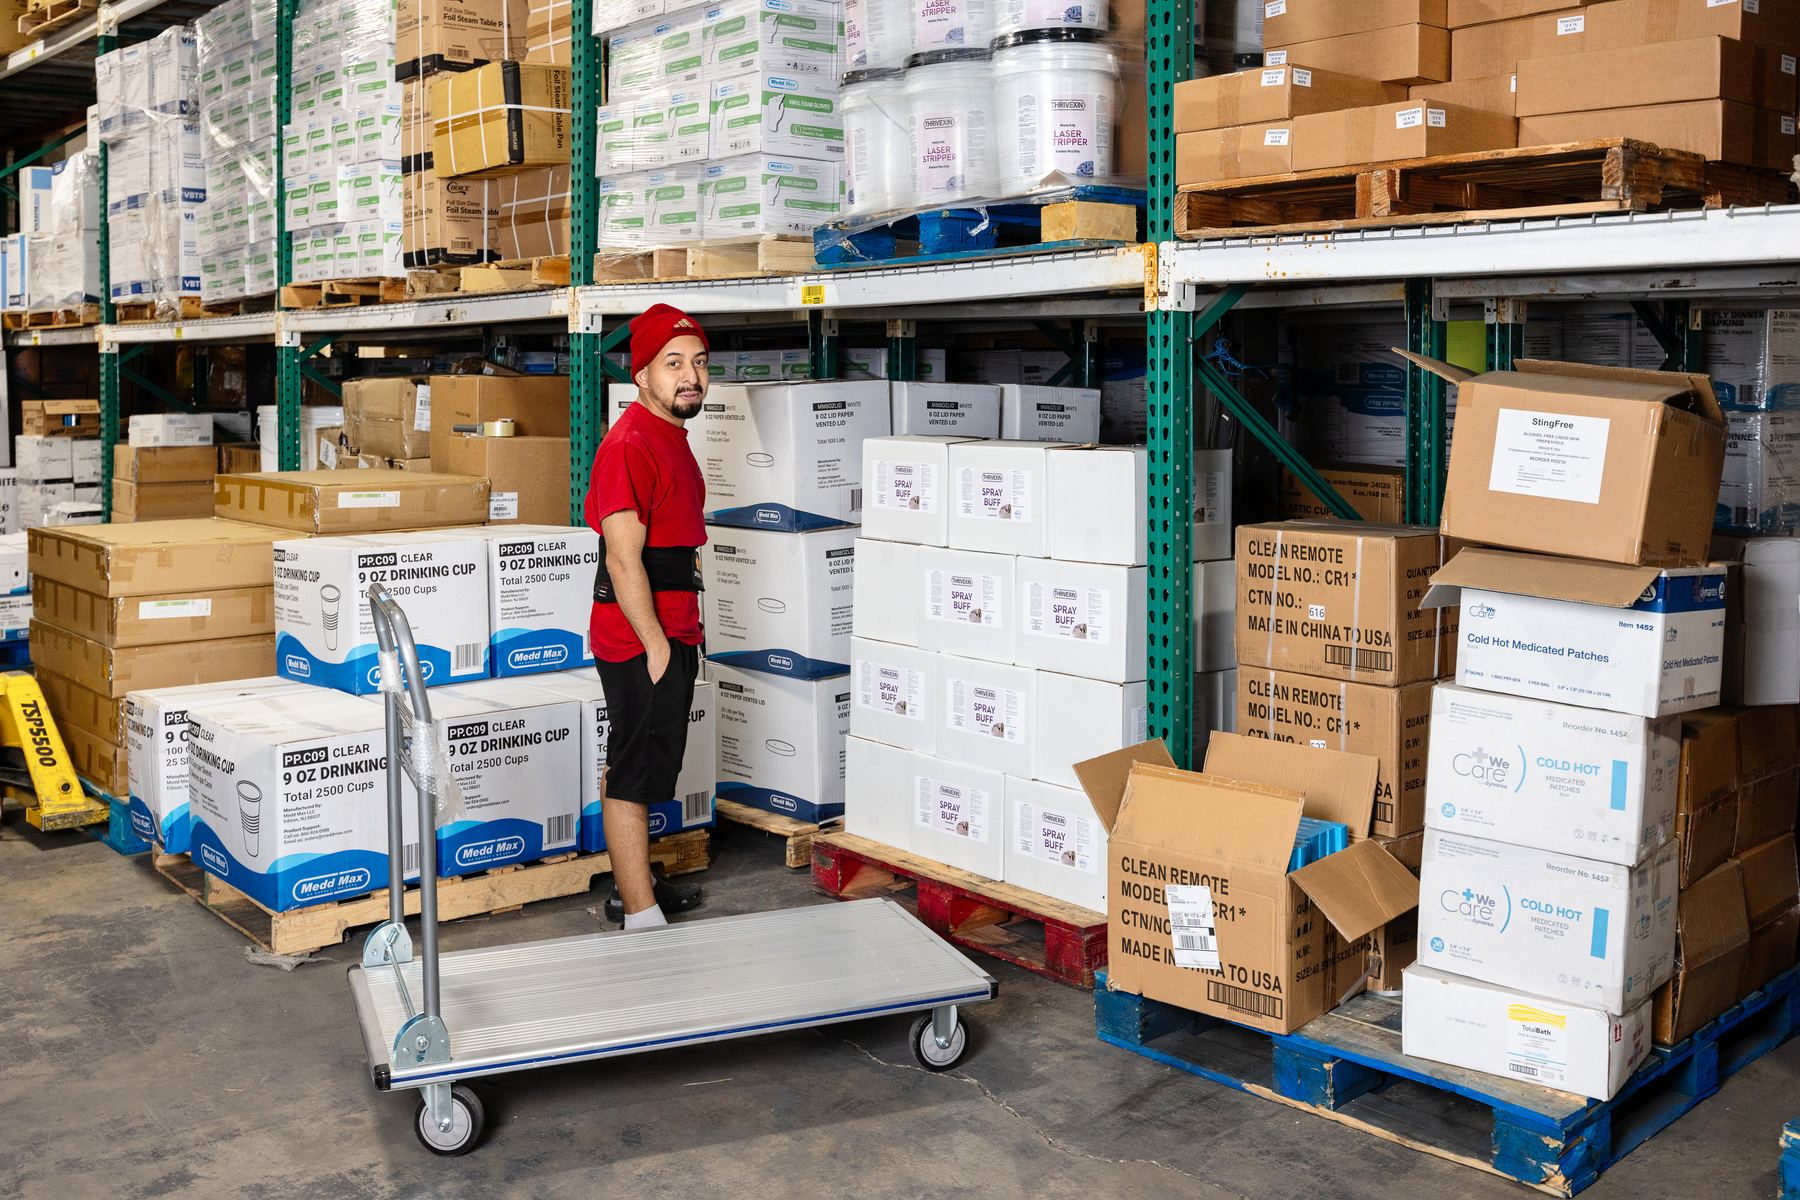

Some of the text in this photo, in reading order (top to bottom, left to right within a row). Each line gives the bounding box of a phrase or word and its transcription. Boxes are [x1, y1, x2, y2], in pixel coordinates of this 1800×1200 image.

[922, 6, 957, 18] STRIPPER
[457, 16, 479, 24] Steam
[801, 100, 814, 108] EXAM
[814, 102, 831, 110] GLOVES
[1051, 100, 1084, 108] THRIVEXIN
[925, 119, 953, 128] THRIVEXIN
[1054, 130, 1082, 138] LASER
[926, 146, 951, 154] LASER
[922, 154, 956, 162] STRIPPER
[446, 206, 482, 215] Foil Steam
[1532, 418, 1574, 430] StingFree
[894, 480, 913, 488] SPRAY
[896, 489, 911, 498] BUFF
[982, 488, 1003, 497] SPRAY
[983, 498, 1001, 506] BUFF
[500, 542, 566, 556] PP.C09 CLEAR
[1248, 540, 1344, 564] CLEAN REMOTE
[359, 552, 433, 567] PP.C09 CLEAR
[500, 554, 581, 572] 9 OZ DRINKING
[308, 571, 320, 582] CUP
[358, 564, 476, 584] 9 OZ DRINKING CUP
[829, 568, 850, 576] VENTED
[1248, 563, 1291, 582] MODEL
[500, 572, 570, 586] Total 2500 Cups
[414, 584, 438, 596] Cups
[951, 590, 973, 601] SPRAY
[953, 600, 972, 610] BUFF
[1052, 604, 1078, 615] SPRAY
[1486, 606, 1496, 614] We
[1308, 607, 1325, 618] 616
[1468, 604, 1495, 620] Care
[1054, 615, 1075, 625] BUFF
[1618, 620, 1654, 632] Item 1452
[1248, 616, 1392, 648] MADE IN CHINA TO USA
[1467, 633, 1610, 663] Cold Hot Medicated Patches
[514, 649, 563, 662] Medd Max
[1664, 660, 1672, 670] Cold
[1682, 656, 1703, 668] Medicated
[1703, 655, 1719, 664] Patches
[879, 682, 898, 692] SPRAY
[1248, 680, 1289, 701] CLEAN
[880, 692, 897, 702] BUFF
[974, 702, 996, 714] SPRAY
[975, 712, 994, 724] BUFF
[20, 700, 57, 768] TSP5500
[449, 720, 526, 738] PP.C09 CLEAR
[596, 725, 604, 738] 9
[1562, 722, 1629, 738] Reorder No. 1452
[165, 732, 174, 744] 9
[449, 728, 570, 756] 9 OZ DRINKING CUP
[166, 746, 183, 756] 100
[284, 744, 370, 766] PP.C09 CLEAR
[166, 758, 178, 767] 25
[196, 744, 220, 770] DRINKING
[221, 760, 235, 776] CUP
[476, 754, 529, 770] 2500 Cups
[1489, 756, 1510, 769] We
[1536, 756, 1600, 777] COLD HOT
[283, 757, 388, 786] 9 OZ DRINKING
[1452, 753, 1506, 782] Care
[1546, 775, 1586, 787] MEDICATED
[284, 781, 374, 802] Total 2500 Cups
[1550, 783, 1580, 794] PATCHES
[939, 800, 960, 812] SPRAY
[941, 810, 959, 822] BUFF
[1042, 828, 1066, 841] SPRAY
[462, 841, 518, 859] Medd Max
[1044, 838, 1064, 851] BUFF
[1122, 856, 1229, 896] CLEAN REMOTE
[1546, 862, 1610, 882] Reorder No. 1452
[300, 873, 364, 894] Medd Max
[1122, 881, 1168, 906] MODEL
[1440, 890, 1494, 920] Care
[1476, 894, 1496, 908] We
[1520, 898, 1582, 922] COLD HOT
[1530, 916, 1569, 930] MEDICATED
[1534, 925, 1564, 938] PATCHES
[1432, 940, 1443, 948] 36
[1122, 937, 1160, 962] MADE
[1164, 948, 1176, 966] IN
[1228, 964, 1248, 985] TO
[1252, 969, 1282, 994] USA
[1522, 1024, 1551, 1036] TotalBath
